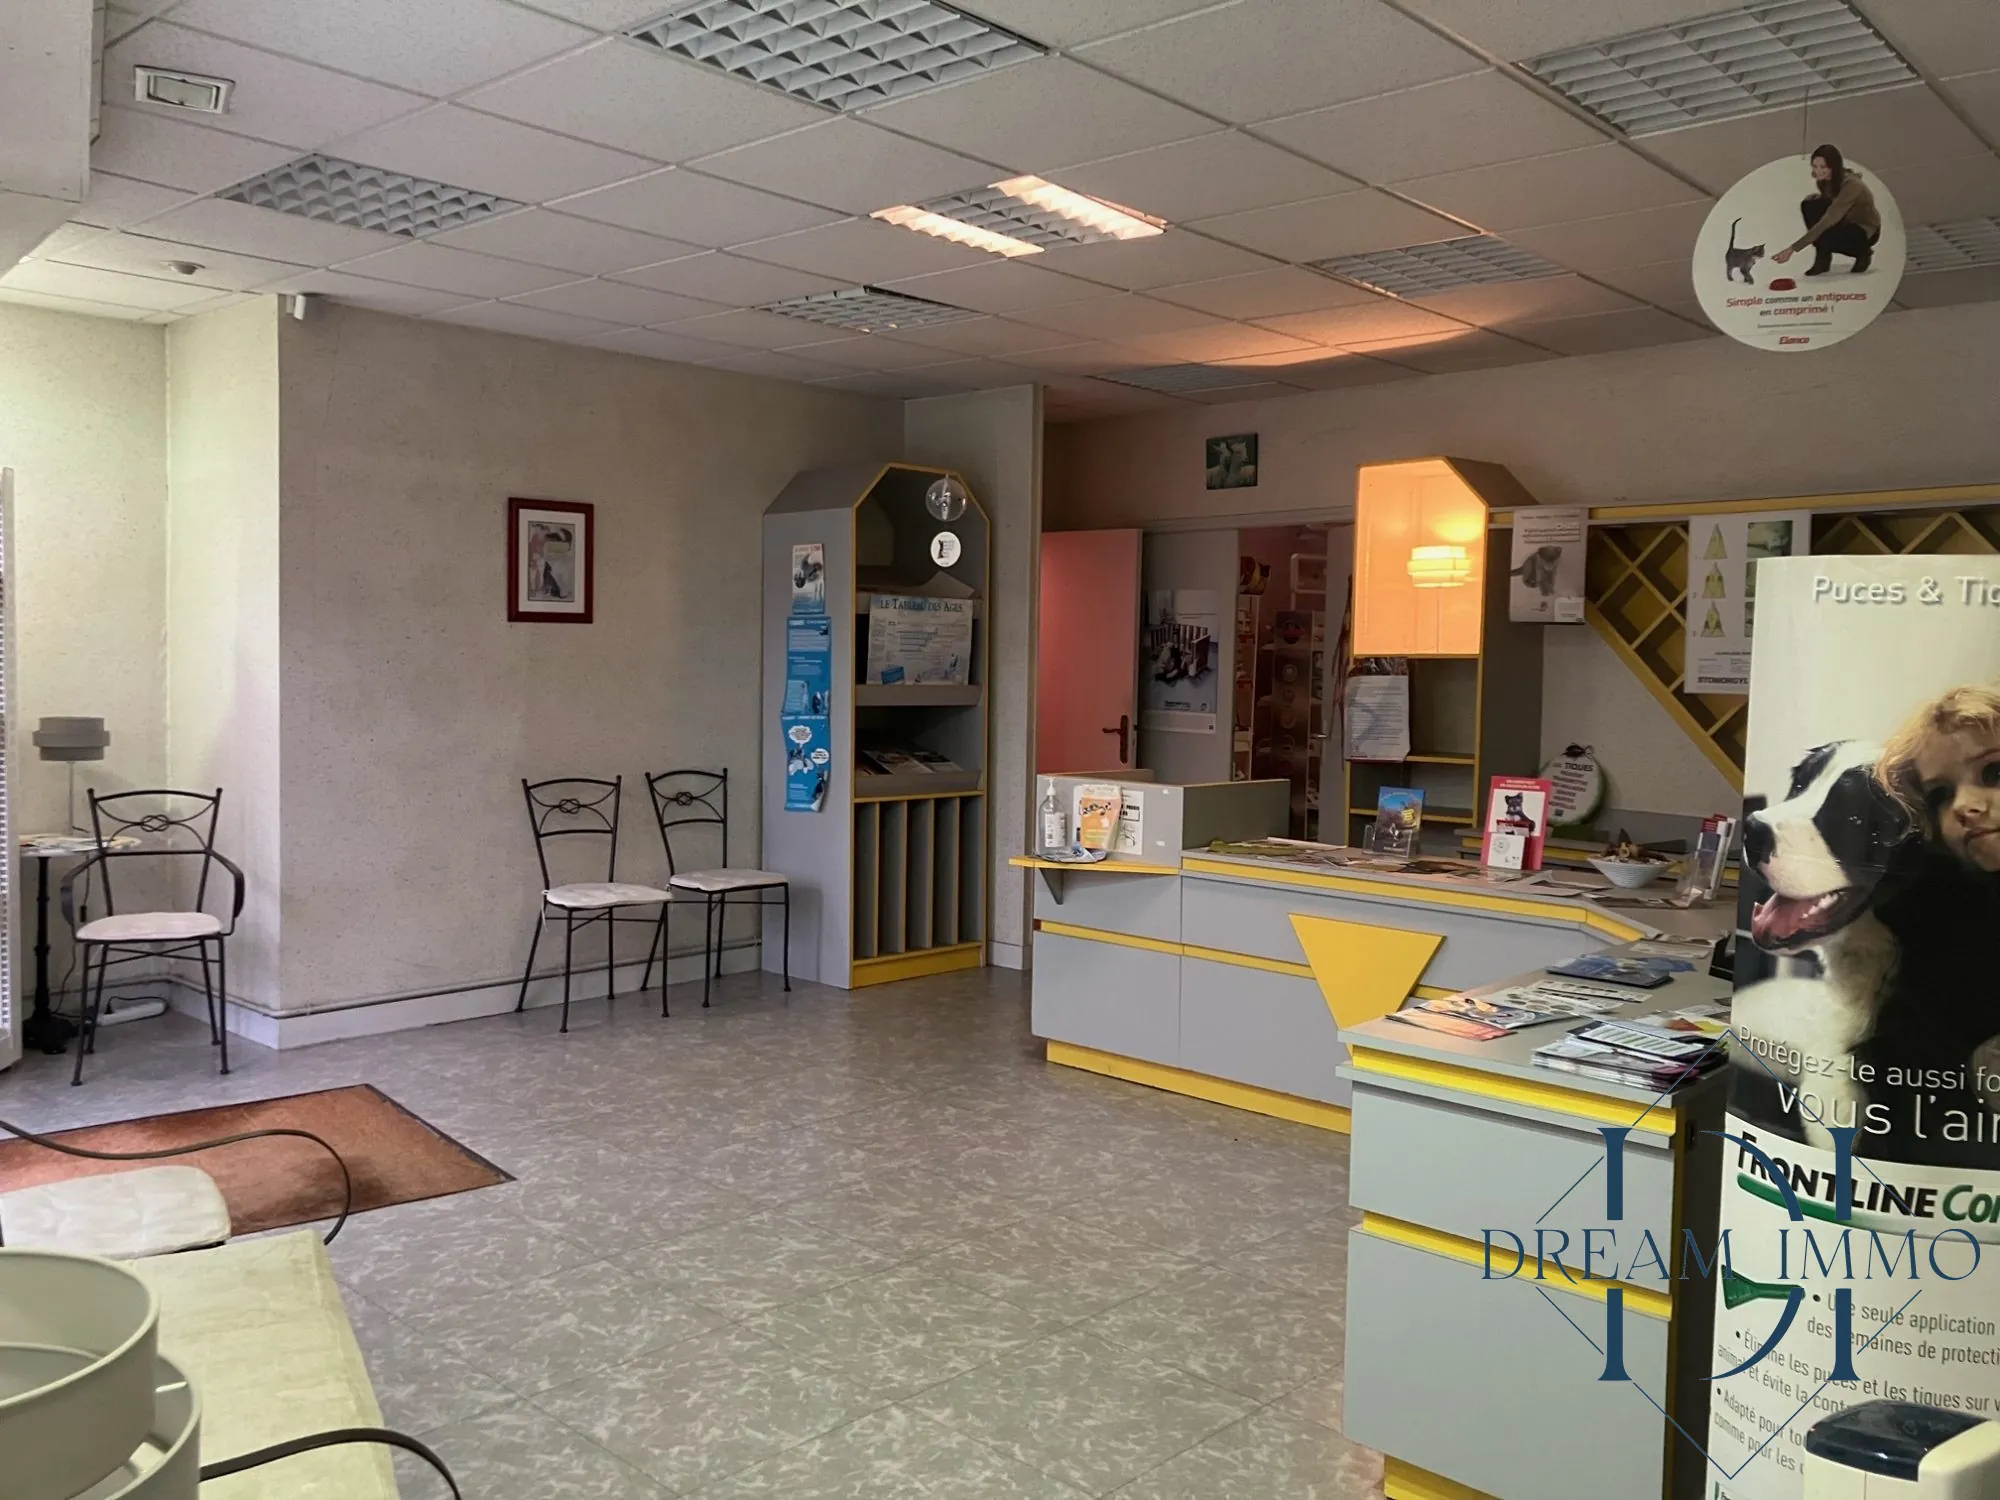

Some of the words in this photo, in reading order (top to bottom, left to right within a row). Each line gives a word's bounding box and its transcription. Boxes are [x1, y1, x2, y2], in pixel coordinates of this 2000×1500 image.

[1726, 296, 1763, 308] Simple
[1764, 296, 1799, 304] comme
[1815, 292, 1867, 302] antipuces
[1773, 303, 1828, 316] comprimé
[1813, 575, 1905, 605] Puces
[1916, 575, 1943, 605] &
[1738, 1024, 1875, 1083] Protégez-le
[1886, 1064, 1965, 1090] aussi
[1976, 1066, 2000, 1093] fo
[1777, 1082, 1892, 1135] vous
[1915, 1094, 2000, 1143] l'ai
[1943, 1184, 2000, 1223] Co
[1828, 1293, 1856, 1317] Ue
[1861, 1305, 1904, 1326] seule
[1909, 1313, 1995, 1336] application
[1807, 1317, 1832, 1339] des
[1847, 1331, 1912, 1356] maines
[1918, 1340, 1936, 1360] de
[1744, 1329, 1785, 1367] Éline
[1789, 1354, 1809, 1376] les
[1863, 1380, 1878, 1396] et
[1884, 1380, 1907, 1402] les
[1965, 1396, 1990, 1411] sur
[1749, 1365, 1759, 1382] et
[1763, 1370, 1792, 1397] évite
[1796, 1384, 1808, 1403] la
[1813, 1395, 1850, 1414] cont
[1724, 1390, 1756, 1423] Adapté
[1759, 1415, 1784, 1440] pour
[1714, 1411, 1745, 1444] comme
[1748, 1436, 1772, 1460] pour
[1777, 1447, 1796, 1471] les
